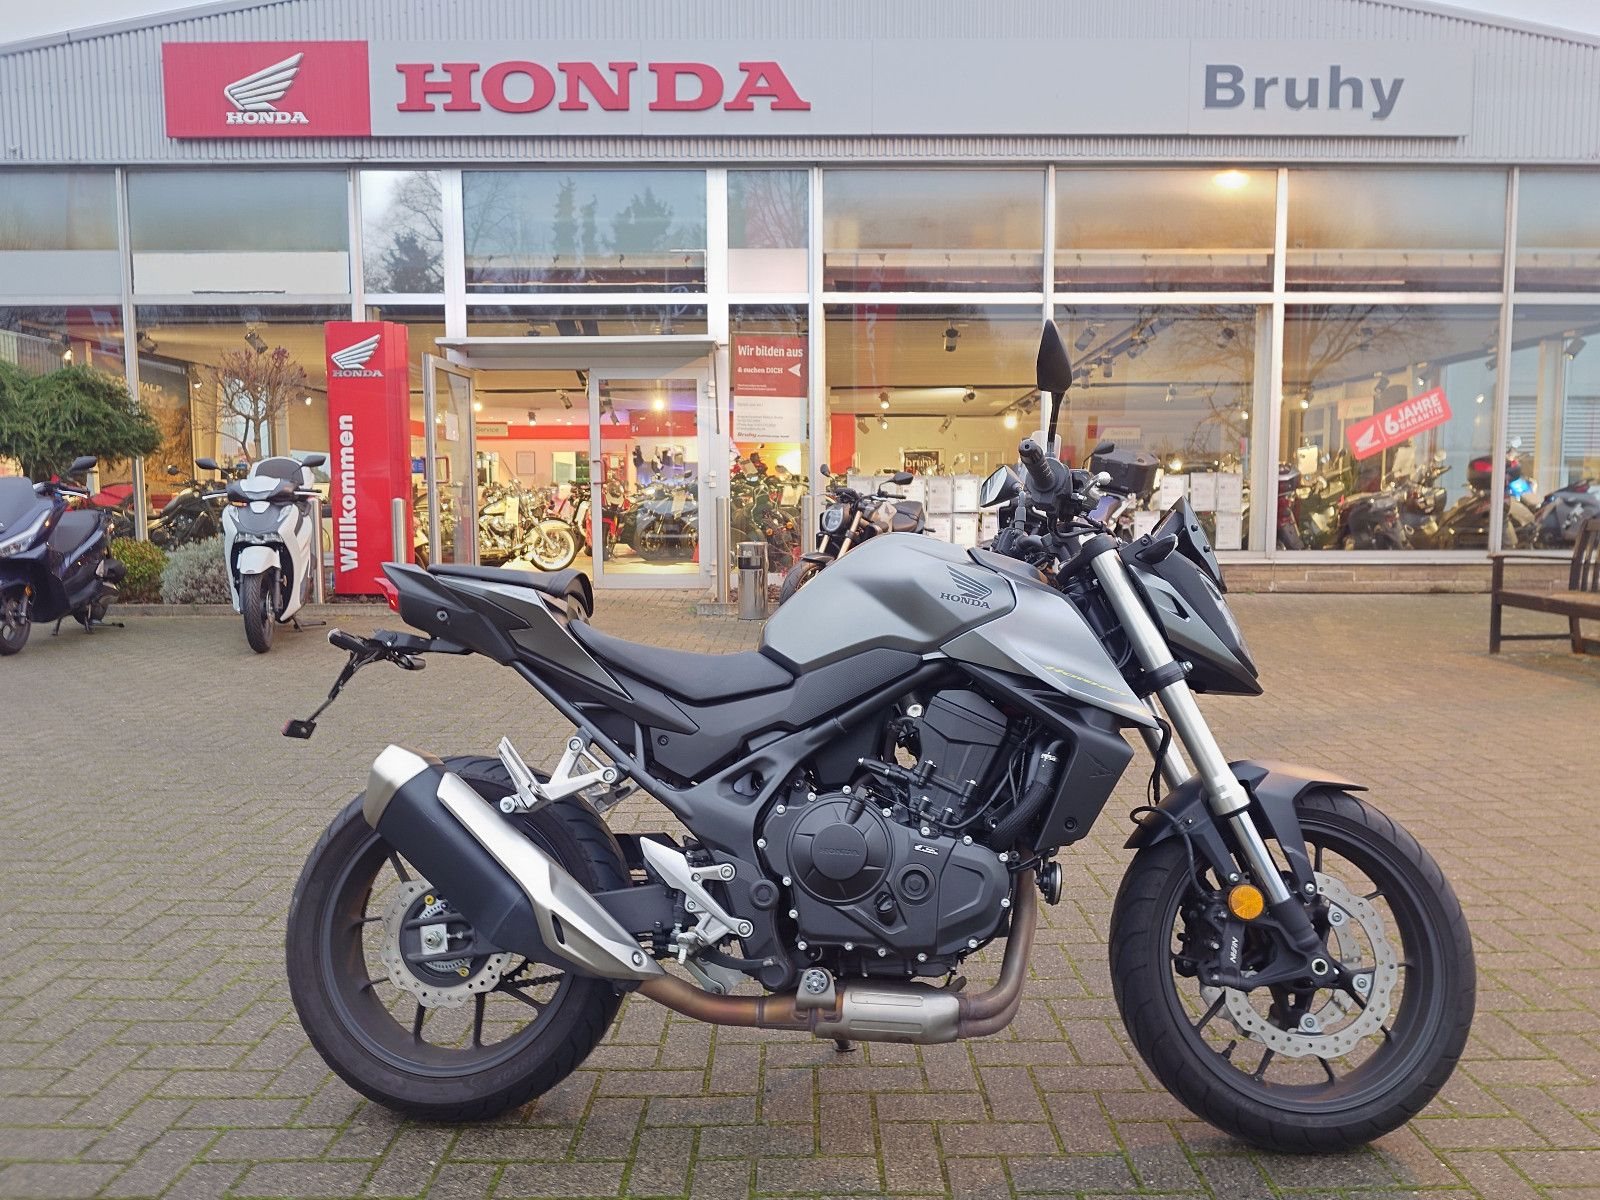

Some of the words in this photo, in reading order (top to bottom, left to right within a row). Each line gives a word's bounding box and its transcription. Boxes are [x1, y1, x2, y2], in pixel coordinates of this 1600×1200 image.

[396, 61, 811, 113] HONDA
[1204, 64, 1405, 121] Bruhy
[226, 111, 310, 125] HONDA
[737, 345, 755, 356] Wir
[755, 345, 785, 357] bilden
[786, 347, 804, 358] aus
[332, 369, 385, 378] HONDA
[743, 366, 765, 374] suchen
[1385, 413, 1400, 435] 6
[1397, 392, 1441, 423] JAHRE
[1399, 404, 1444, 430] GARANTIE
[339, 414, 359, 573] Willkommen
[939, 591, 991, 610] HONDA
